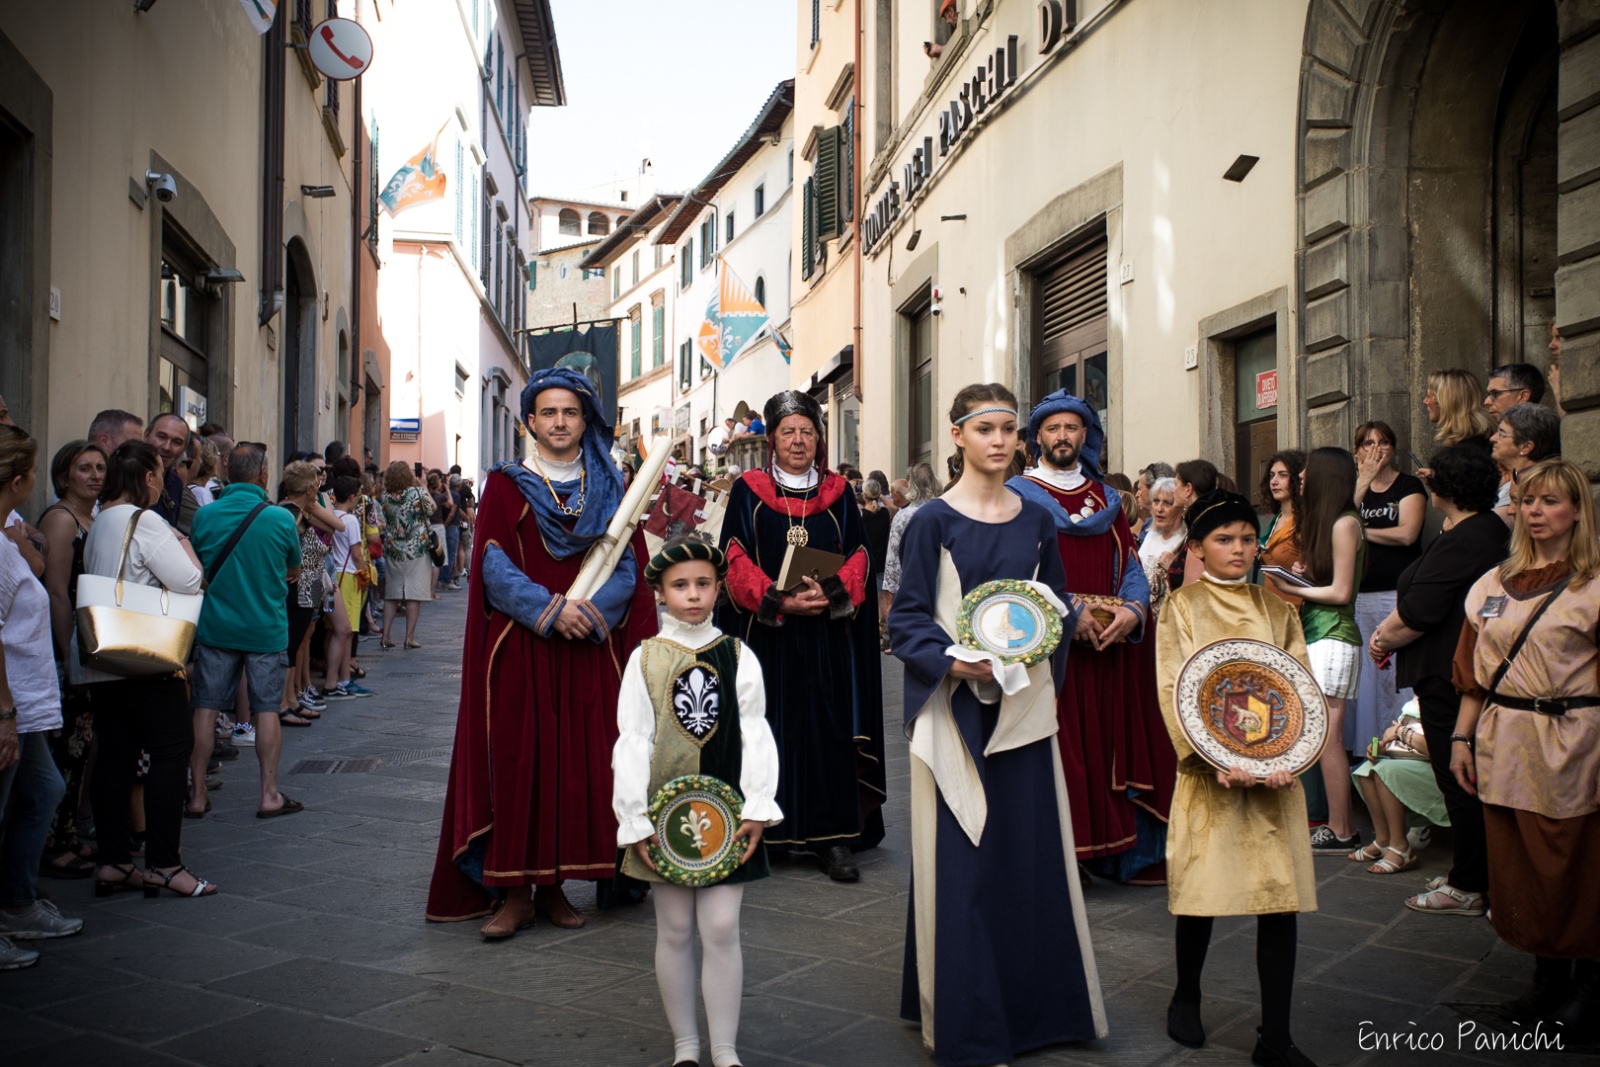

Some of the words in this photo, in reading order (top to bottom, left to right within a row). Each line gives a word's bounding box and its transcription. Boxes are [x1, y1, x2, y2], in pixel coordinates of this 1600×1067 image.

[861, 181, 900, 256] MONTE
[904, 136, 932, 202] DEI
[939, 34, 1018, 156] PASCHI
[1037, 0, 1077, 54] DI
